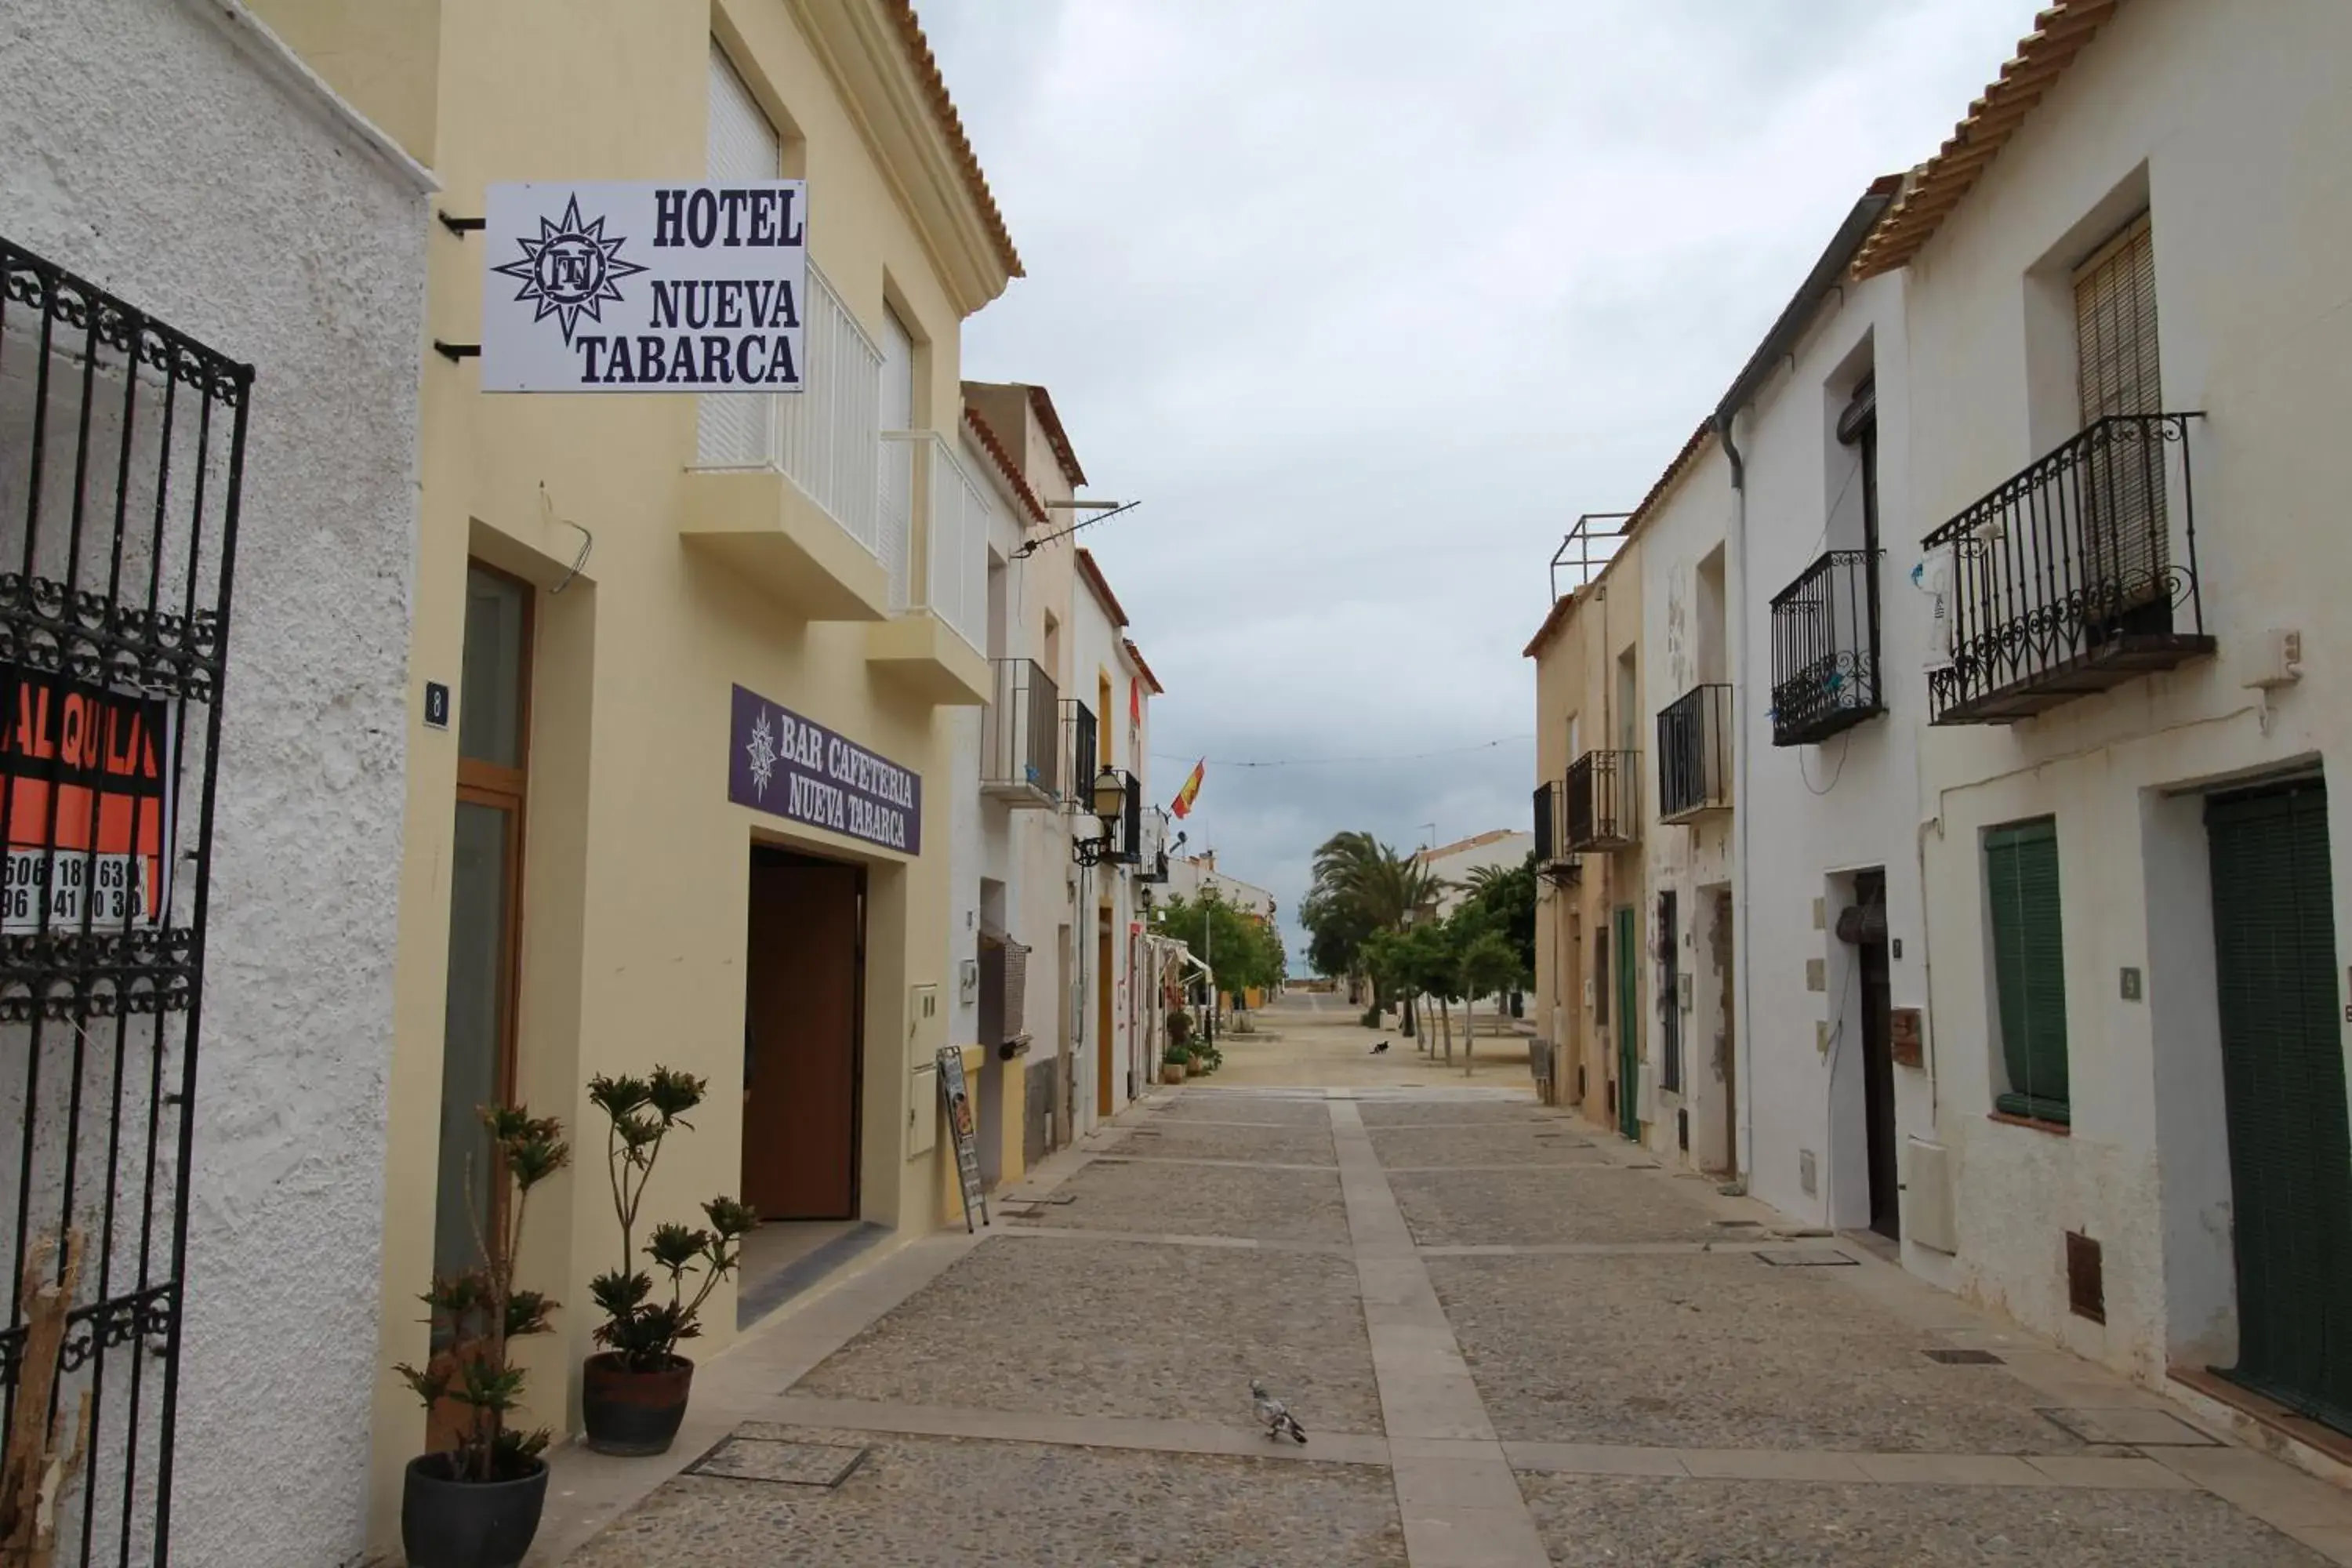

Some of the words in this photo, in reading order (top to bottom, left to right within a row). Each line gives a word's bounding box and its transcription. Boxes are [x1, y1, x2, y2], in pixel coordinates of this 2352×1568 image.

[653, 188, 803, 248] HOTEL
[650, 279, 800, 329] NUEVA
[576, 335, 799, 384] TABARCA
[2, 681, 157, 779] ALQULA
[434, 691, 441, 717] 8
[781, 714, 822, 771] BAR
[828, 738, 913, 808] CAFETERIA
[788, 772, 844, 829] NUEVA
[848, 794, 905, 848] TABARCA
